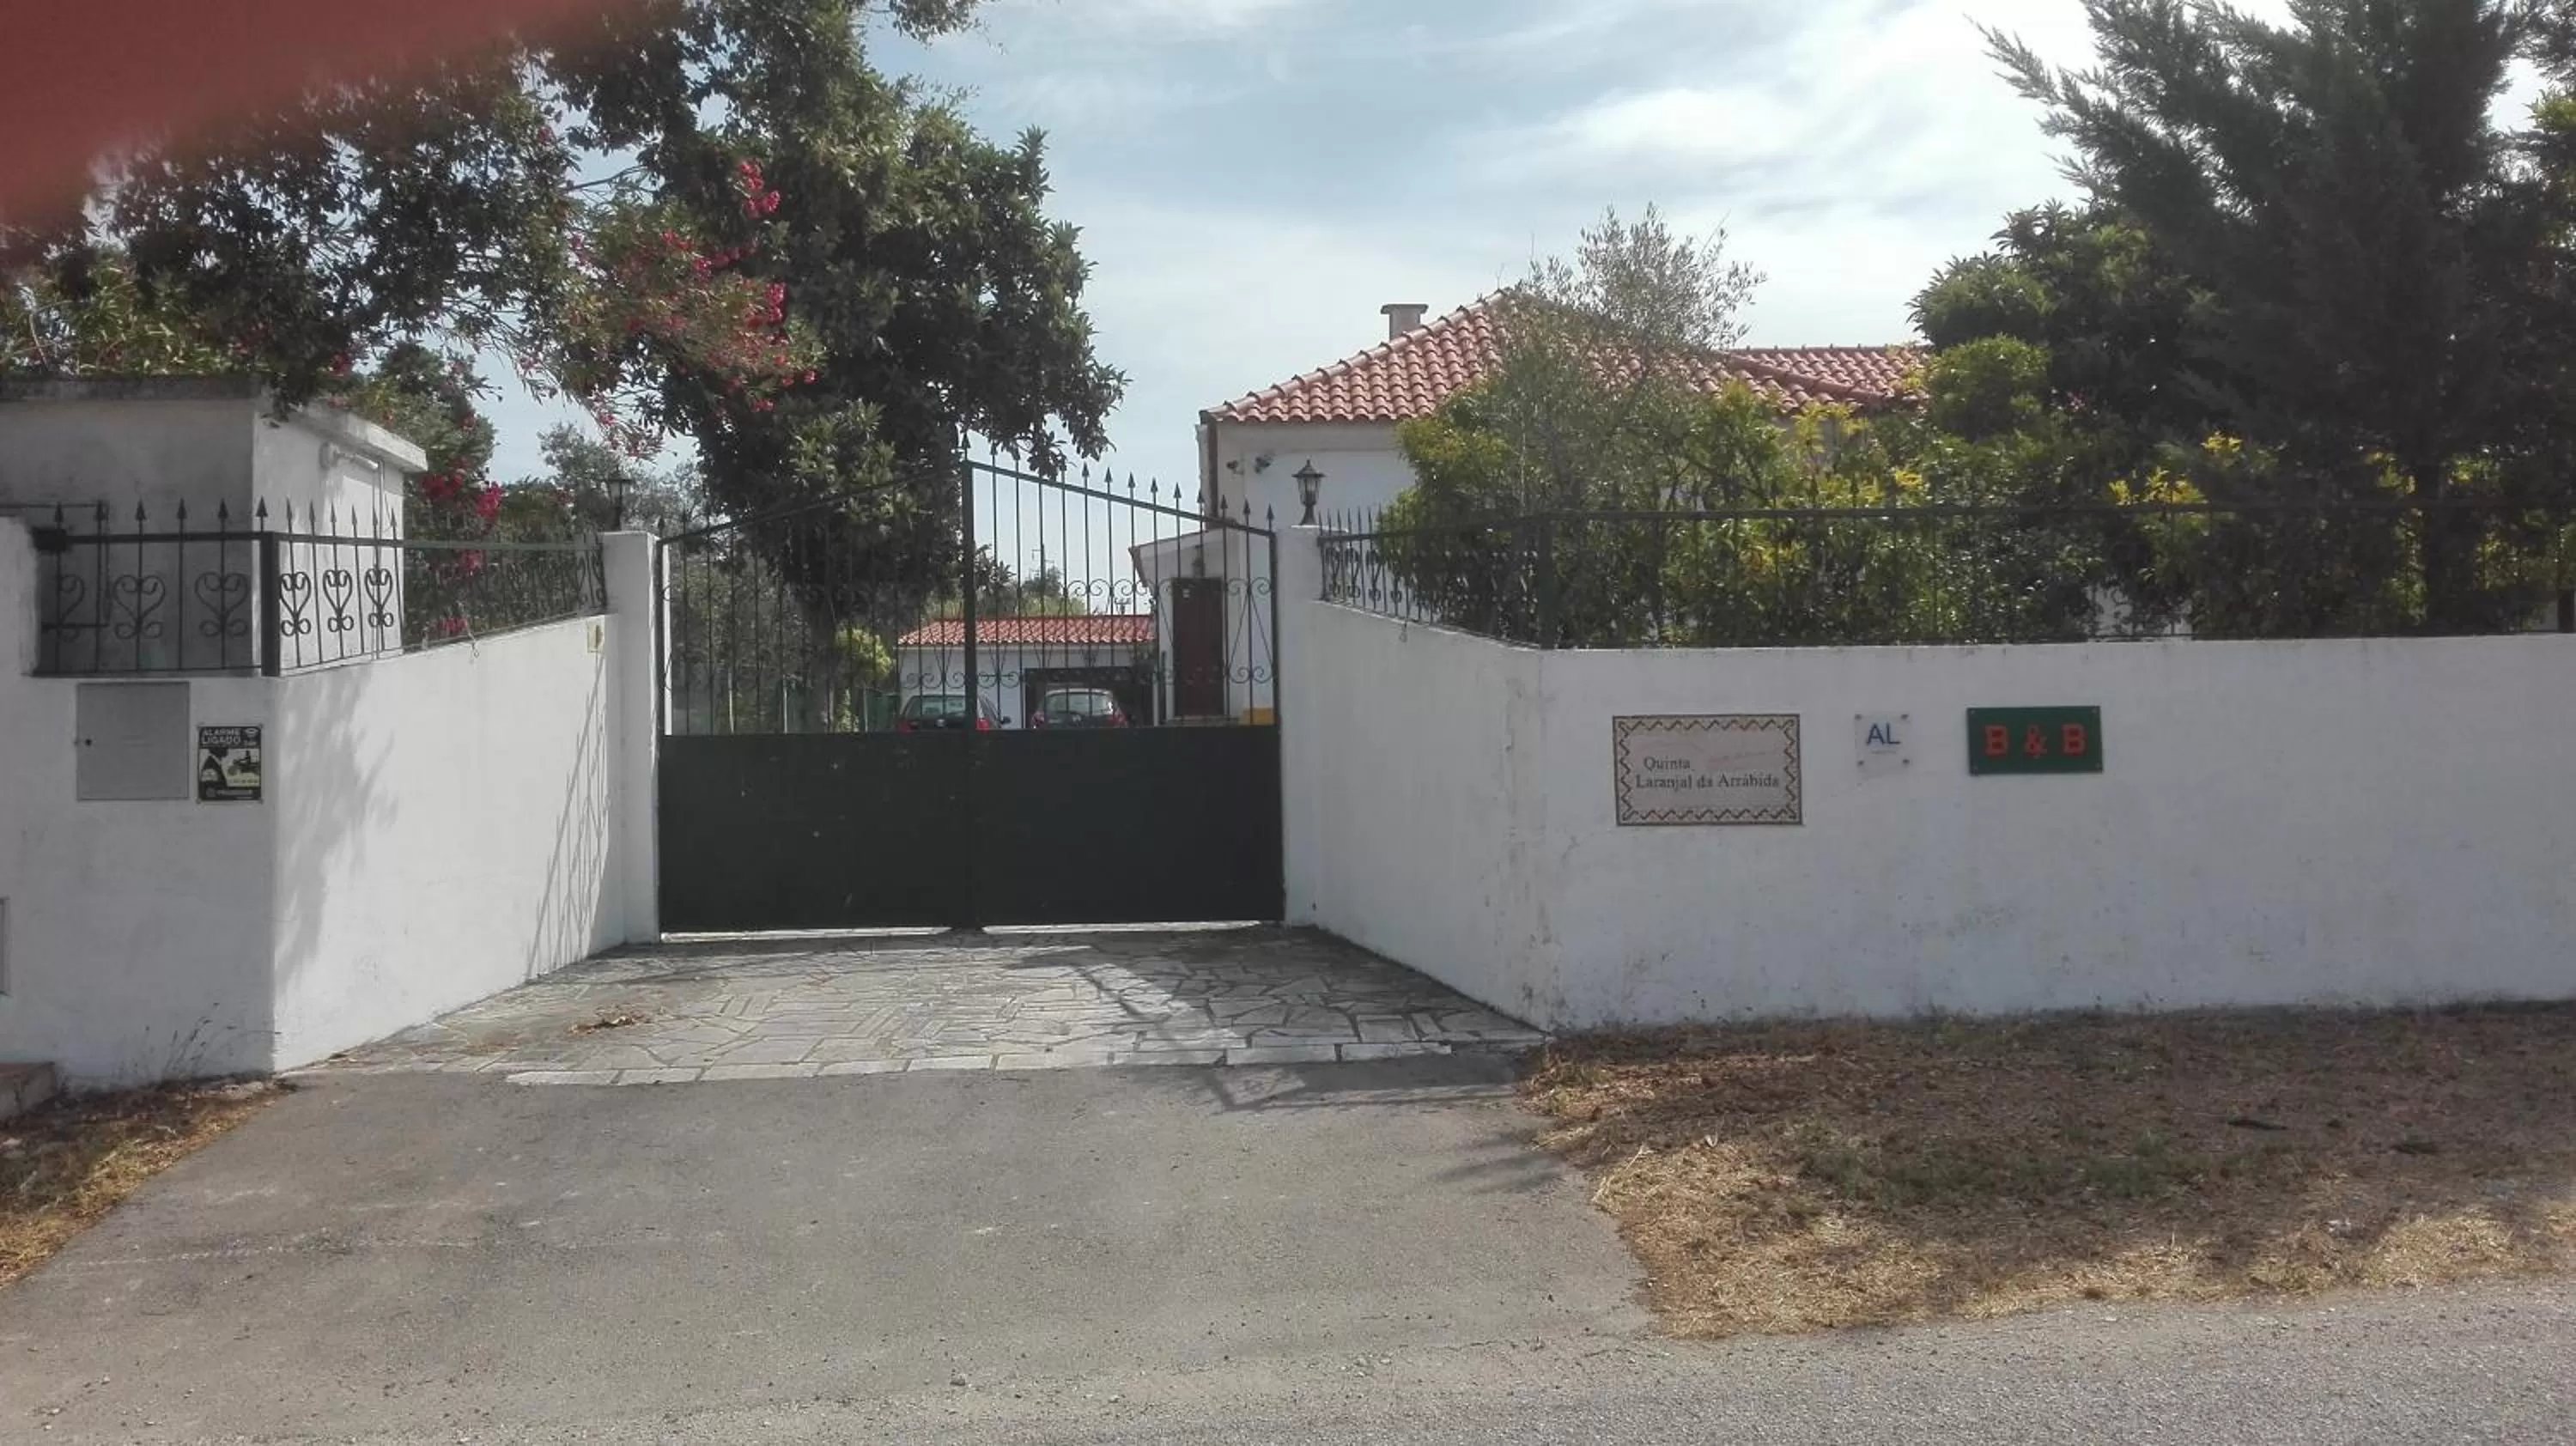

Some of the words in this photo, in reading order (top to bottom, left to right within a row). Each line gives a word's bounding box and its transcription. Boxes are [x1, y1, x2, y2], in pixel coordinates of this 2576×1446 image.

[1866, 723, 1901, 744] AL
[1984, 723, 2008, 756] B
[2025, 724, 2048, 758] &
[2063, 723, 2087, 756] B
[1643, 756, 1691, 770] Quinta
[1636, 774, 1692, 791] Laranjal
[1697, 775, 1713, 788] da
